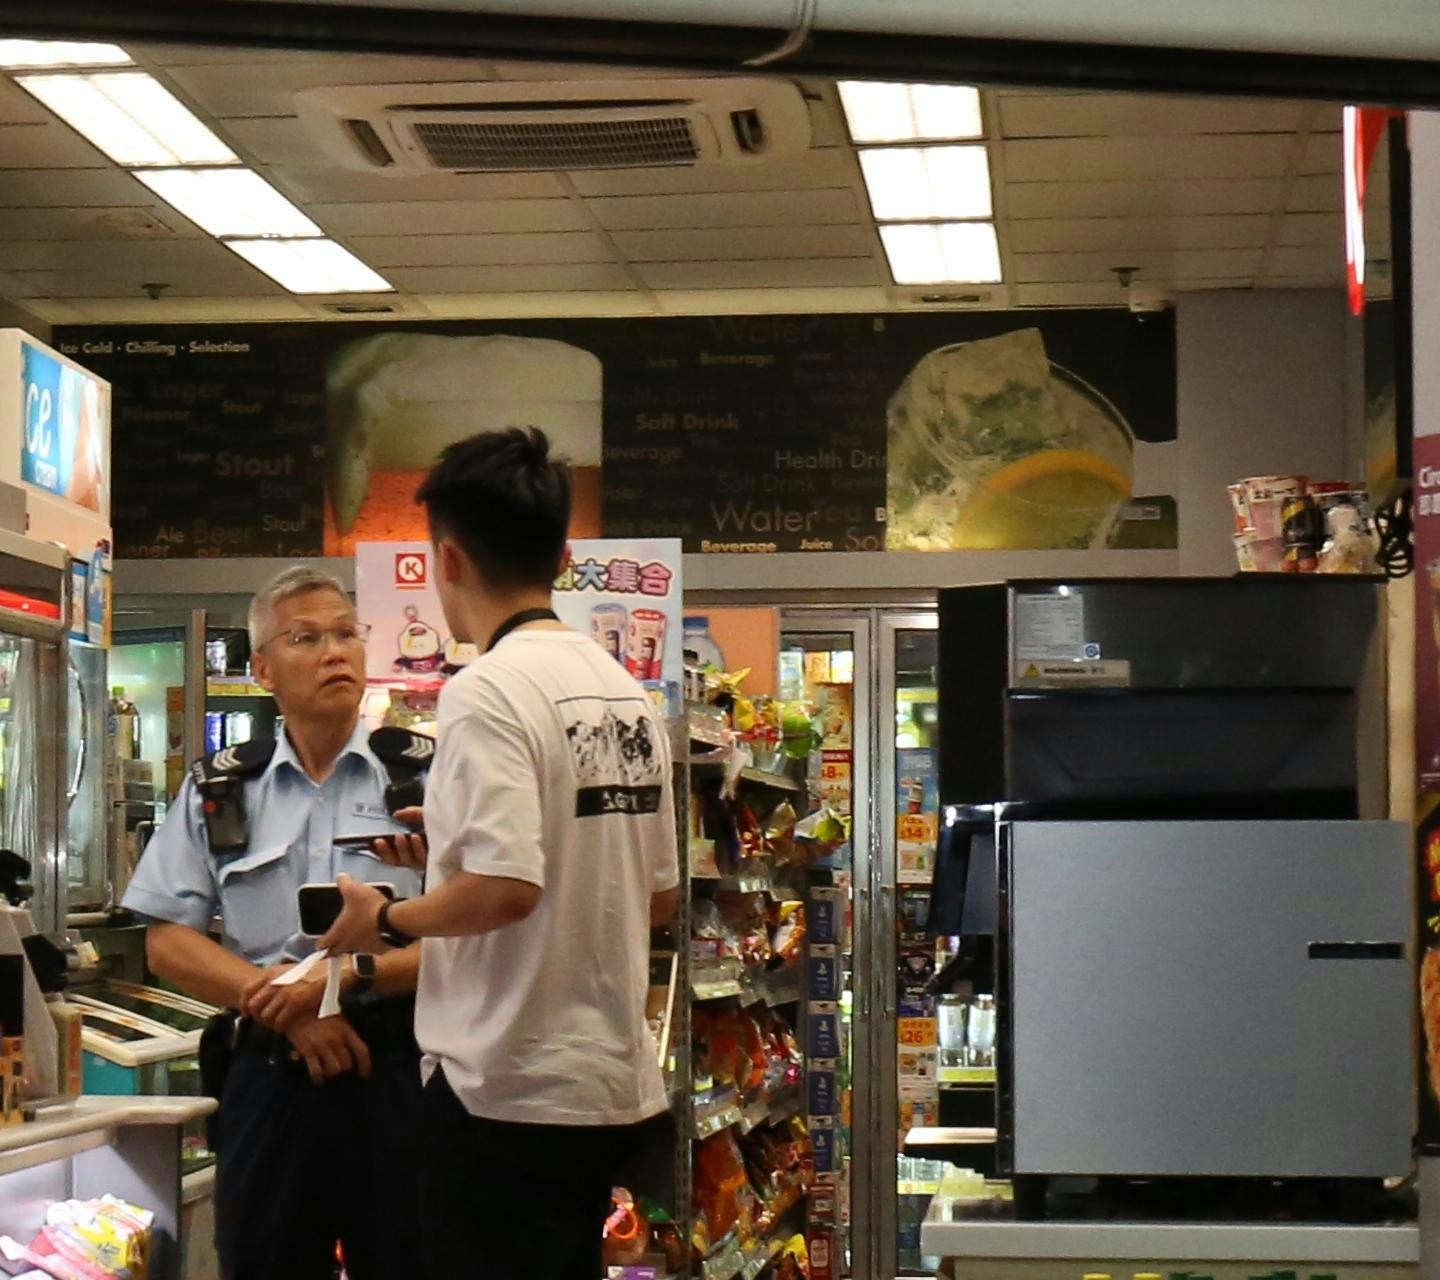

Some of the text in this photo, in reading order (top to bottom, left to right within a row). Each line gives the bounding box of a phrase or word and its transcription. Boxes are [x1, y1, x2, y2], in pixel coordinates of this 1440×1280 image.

[83, 341, 113, 354] Cold
[125, 341, 176, 357] Chilling
[189, 341, 251, 354] Selection
[700, 351, 776, 368] Beverage
[635, 413, 740, 431] Soft Drink
[216, 452, 297, 477] Stout
[775, 450, 887, 470] Health Dri
[709, 499, 818, 534] Water
[156, 526, 185, 545] Ale
[700, 526, 887, 554] Beverage Juice So
